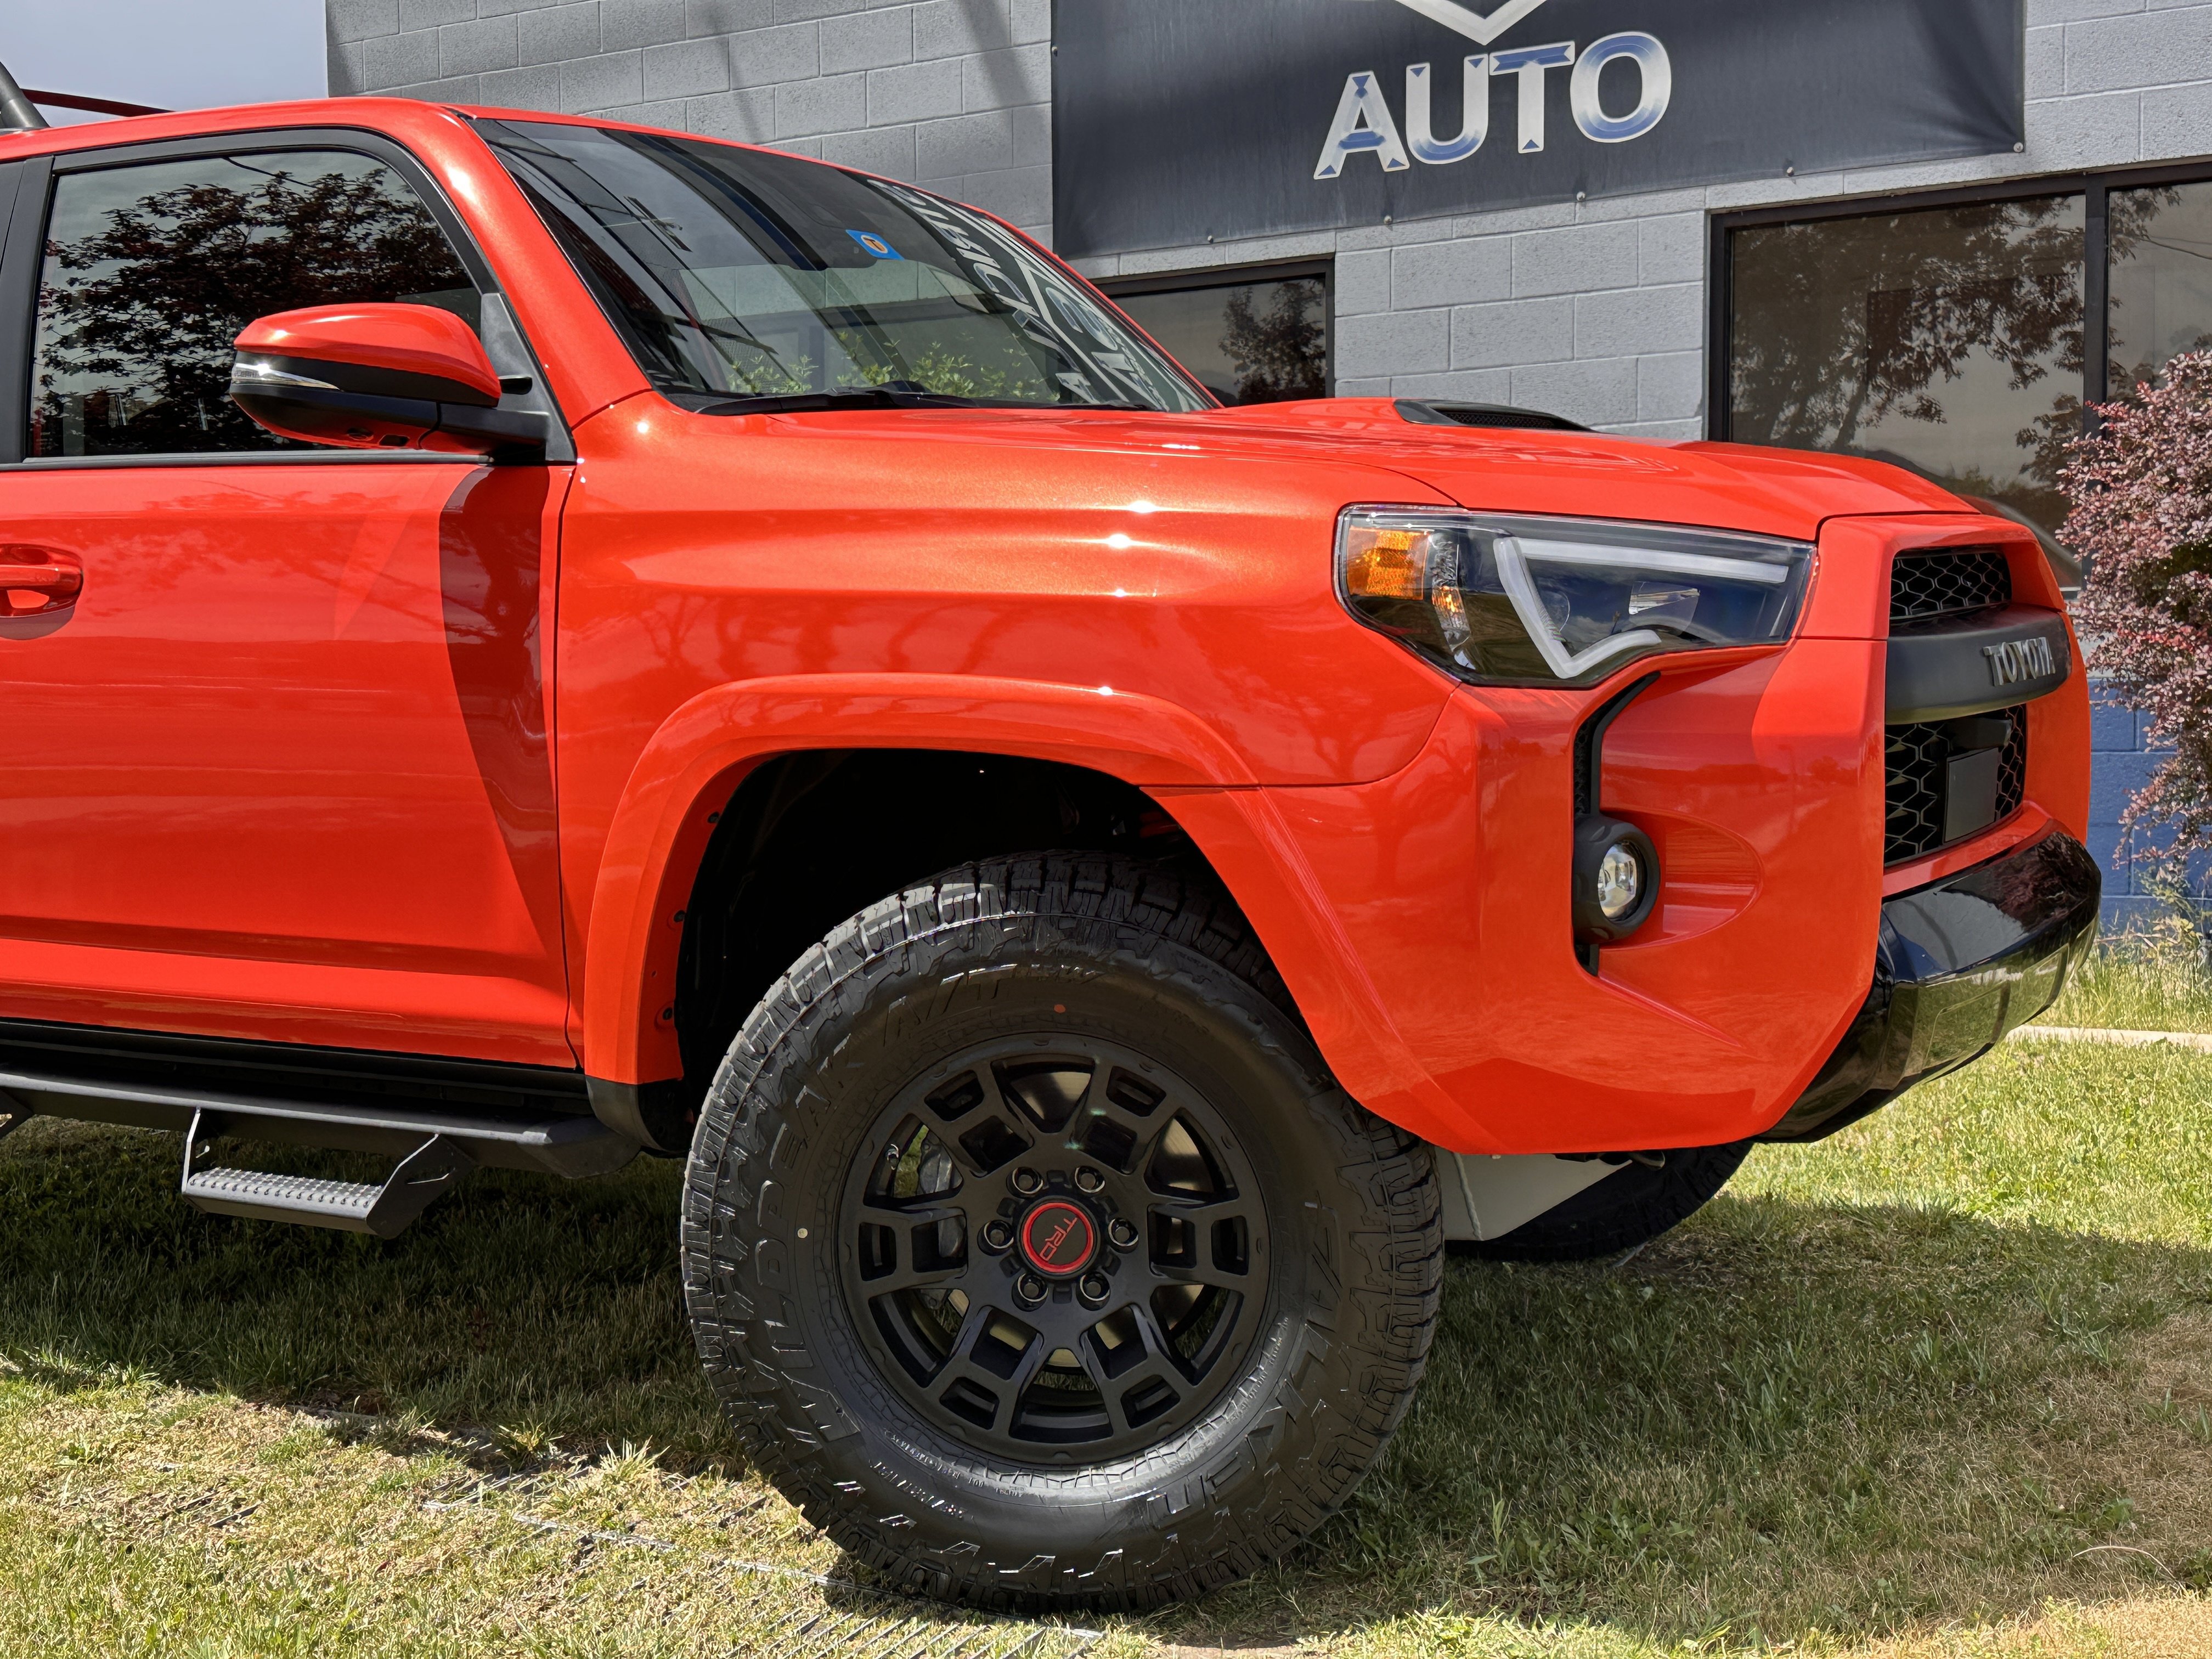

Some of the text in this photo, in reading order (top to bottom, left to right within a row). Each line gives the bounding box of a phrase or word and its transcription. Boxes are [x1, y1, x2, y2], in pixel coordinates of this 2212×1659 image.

[1314, 31, 1672, 179] AUTO
[1983, 637, 2056, 686] TOYOTA
[754, 1032, 865, 1443] WILDPEAK
[1040, 1217, 1077, 1261] TRD
[1146, 1200, 1343, 1530] FALKEN
